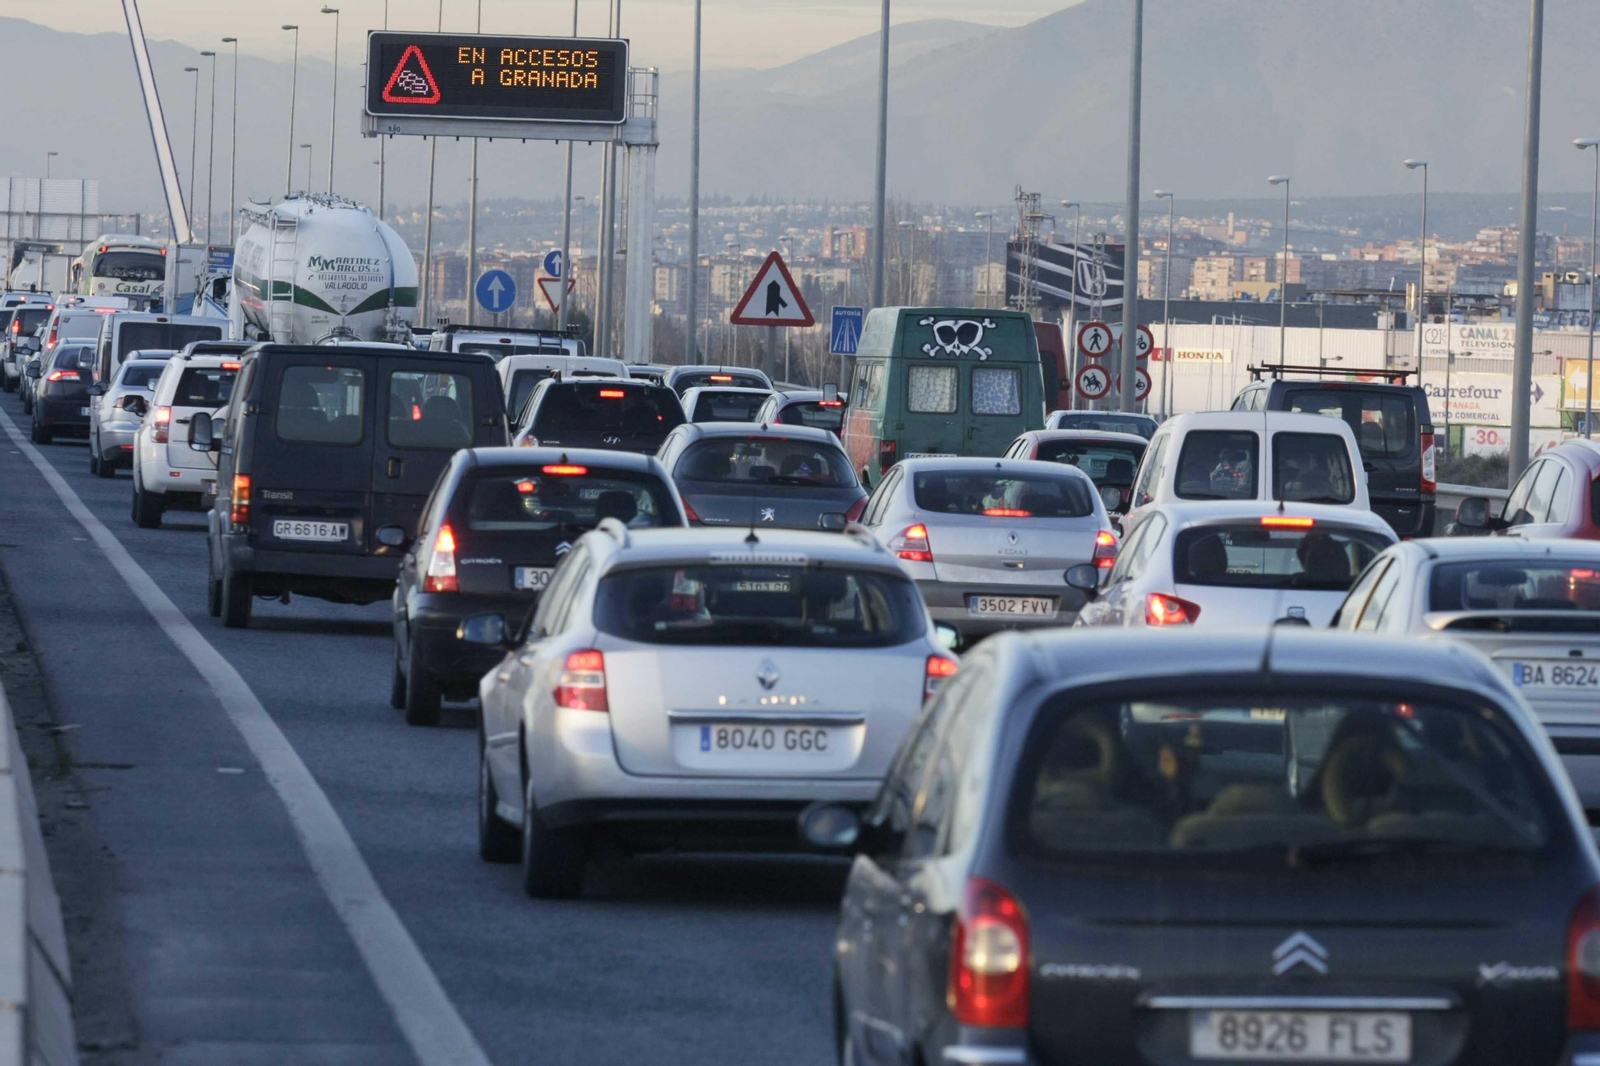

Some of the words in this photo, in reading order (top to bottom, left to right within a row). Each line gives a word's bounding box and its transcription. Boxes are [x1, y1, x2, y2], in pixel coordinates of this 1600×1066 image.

[458, 46, 485, 64] EN
[501, 48, 598, 68] ACCESOS
[472, 68, 484, 85] A
[500, 69, 597, 88] GRANADA
[116, 282, 151, 294] Casal
[325, 282, 368, 290] VALLADOLID
[1460, 327, 1499, 341] CANAL
[1461, 340, 1516, 349] TELEVISION
[1178, 351, 1223, 360] HONDA
[1423, 382, 1502, 399] Carrefour
[1455, 412, 1500, 421] COMERCIAL
[262, 489, 294, 500] Transit
[979, 598, 1015, 613] 3502
[1021, 600, 1048, 614] FVV
[1523, 665, 1545, 685] BA
[1552, 666, 1599, 686] 8624
[716, 728, 775, 750] 8040
[784, 729, 828, 751] GGC
[1218, 1013, 1308, 1052] 8926
[1328, 1016, 1394, 1055] FLS
